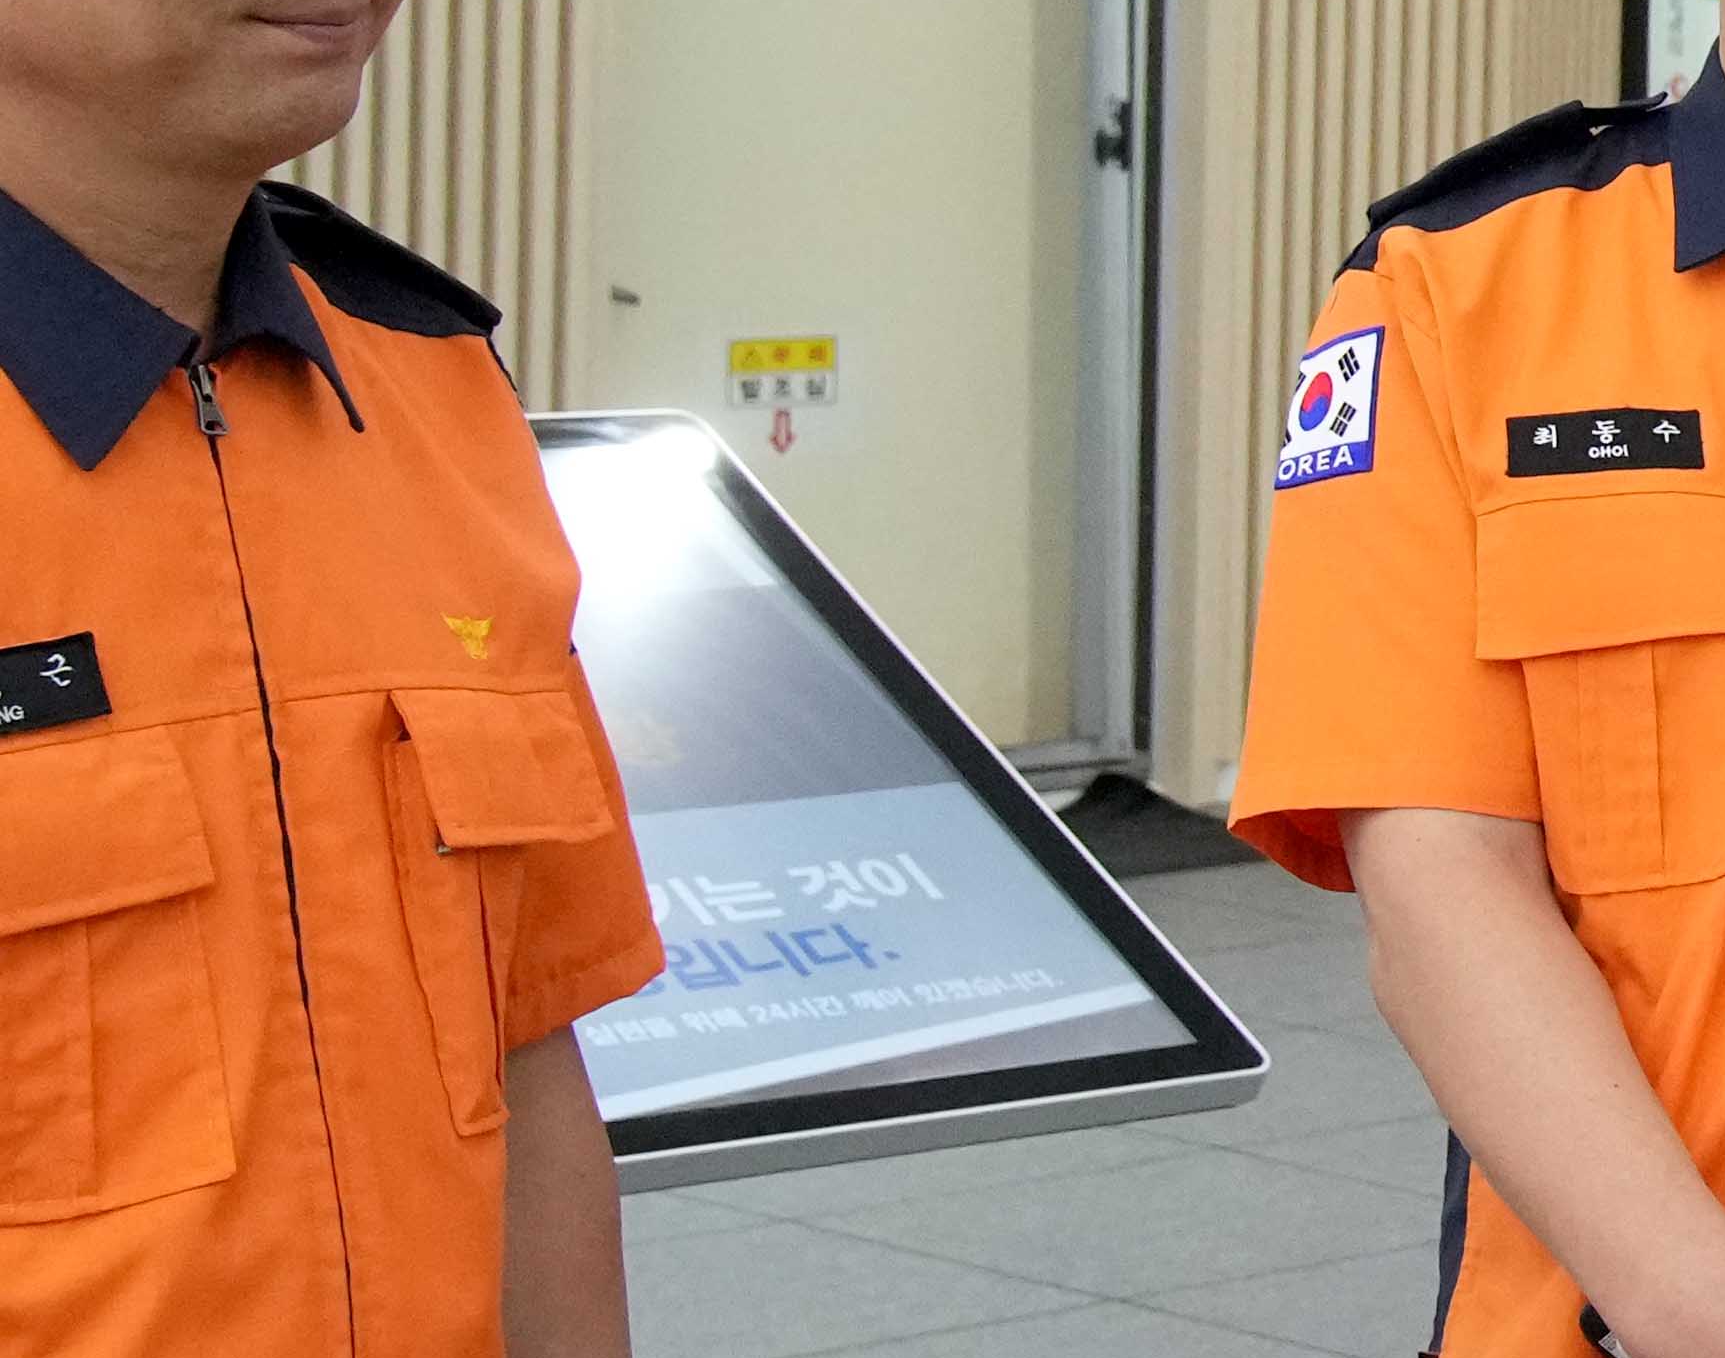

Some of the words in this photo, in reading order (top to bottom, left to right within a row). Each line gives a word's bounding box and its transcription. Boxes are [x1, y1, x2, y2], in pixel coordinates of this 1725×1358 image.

[1277, 454, 1355, 483] OREA
[1588, 444, 1629, 460] CHOI
[788, 853, 945, 913] 것이
[636, 922, 901, 998] 입니다.
[681, 1007, 747, 1036] 위해
[754, 994, 848, 1025] 24시간
[914, 967, 1065, 1004] 있겠습니다.
